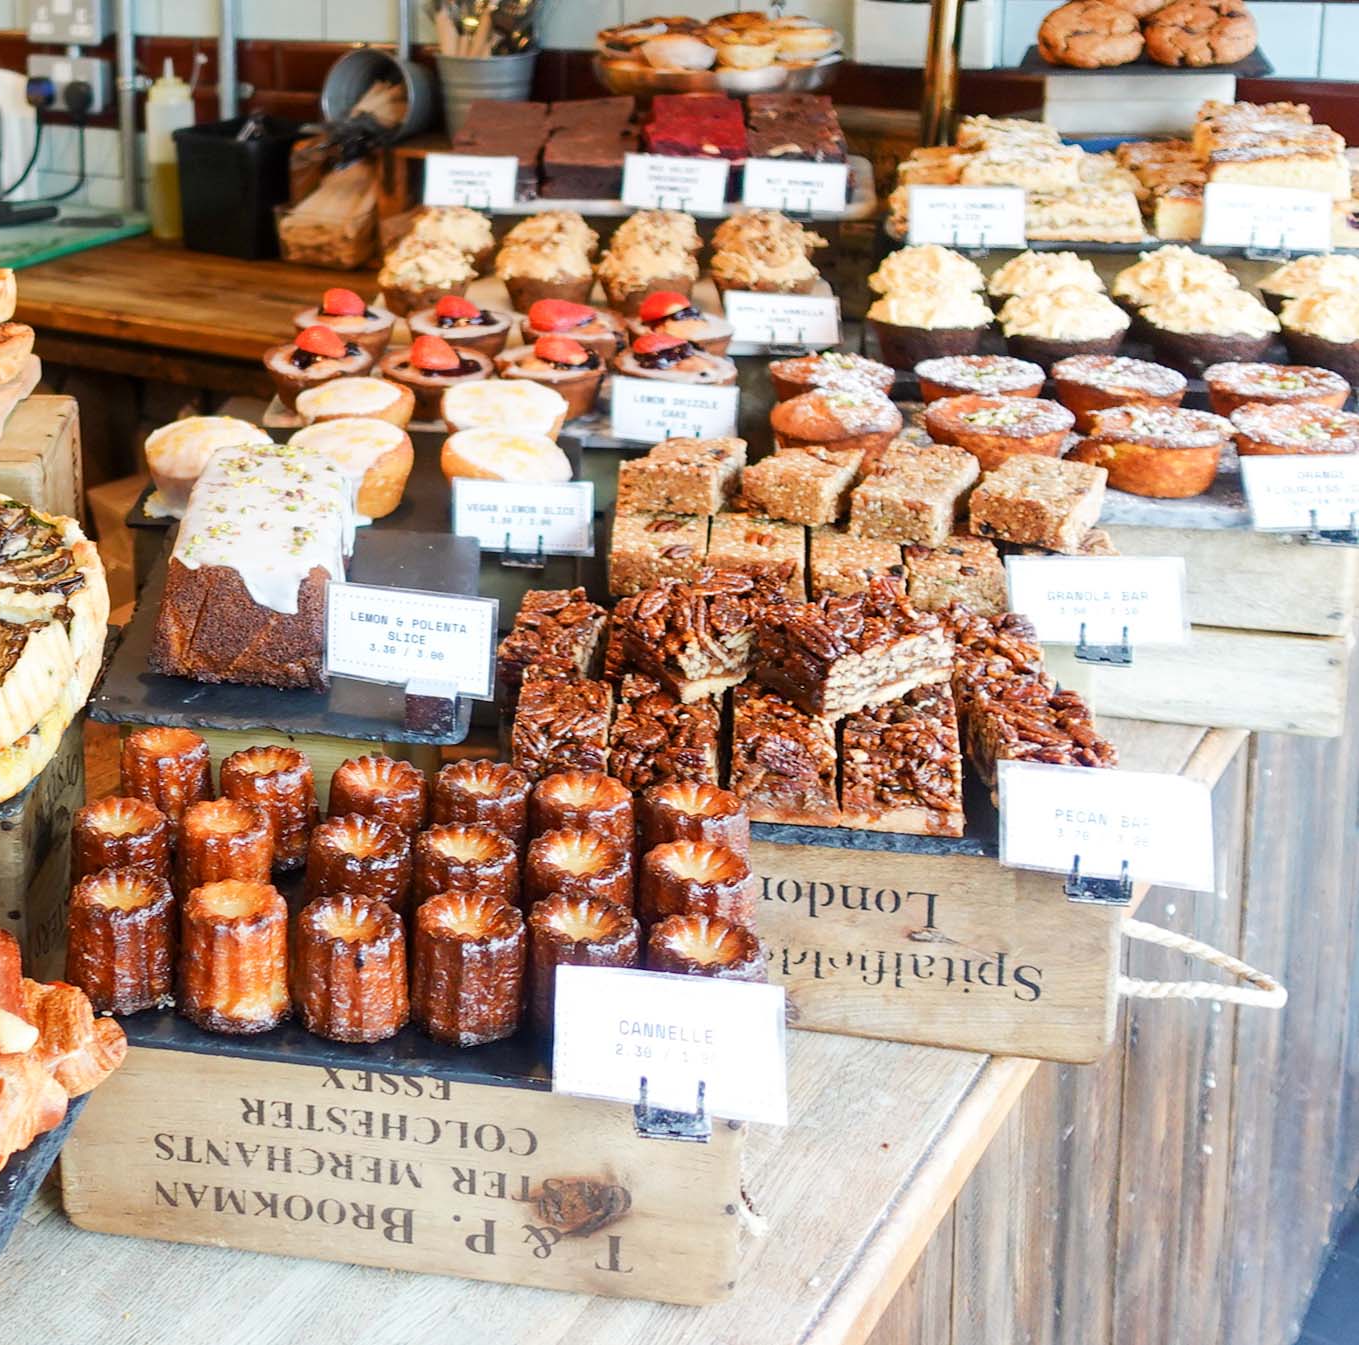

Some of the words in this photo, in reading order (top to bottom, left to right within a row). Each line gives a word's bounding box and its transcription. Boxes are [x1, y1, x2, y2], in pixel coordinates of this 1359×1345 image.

[633, 395, 665, 404] LEMON
[672, 398, 719, 409] DRIZZLE
[466, 504, 498, 512] VEGAN
[505, 505, 536, 514] LEMON
[544, 506, 577, 515] SLICE
[1048, 591, 1111, 601] GRANOLA
[1121, 591, 1149, 601] BAR
[350, 611, 389, 625] LEMON
[396, 617, 404, 627] &
[412, 619, 467, 633] POLENTA
[369, 643, 396, 654] 3.30
[388, 631, 426, 645] SLICE
[1055, 808, 1107, 825] PECAN
[619, 1020, 713, 1044] CANNELLE
[322, 1067, 452, 1101] ESSEX
[240, 1097, 538, 1157] COLCHESTER
[154, 1133, 423, 1189] MERCHANTS
[155, 1180, 414, 1245] BROOKMAN
[452, 1215, 497, 1256] P.
[522, 1224, 562, 1260] &
